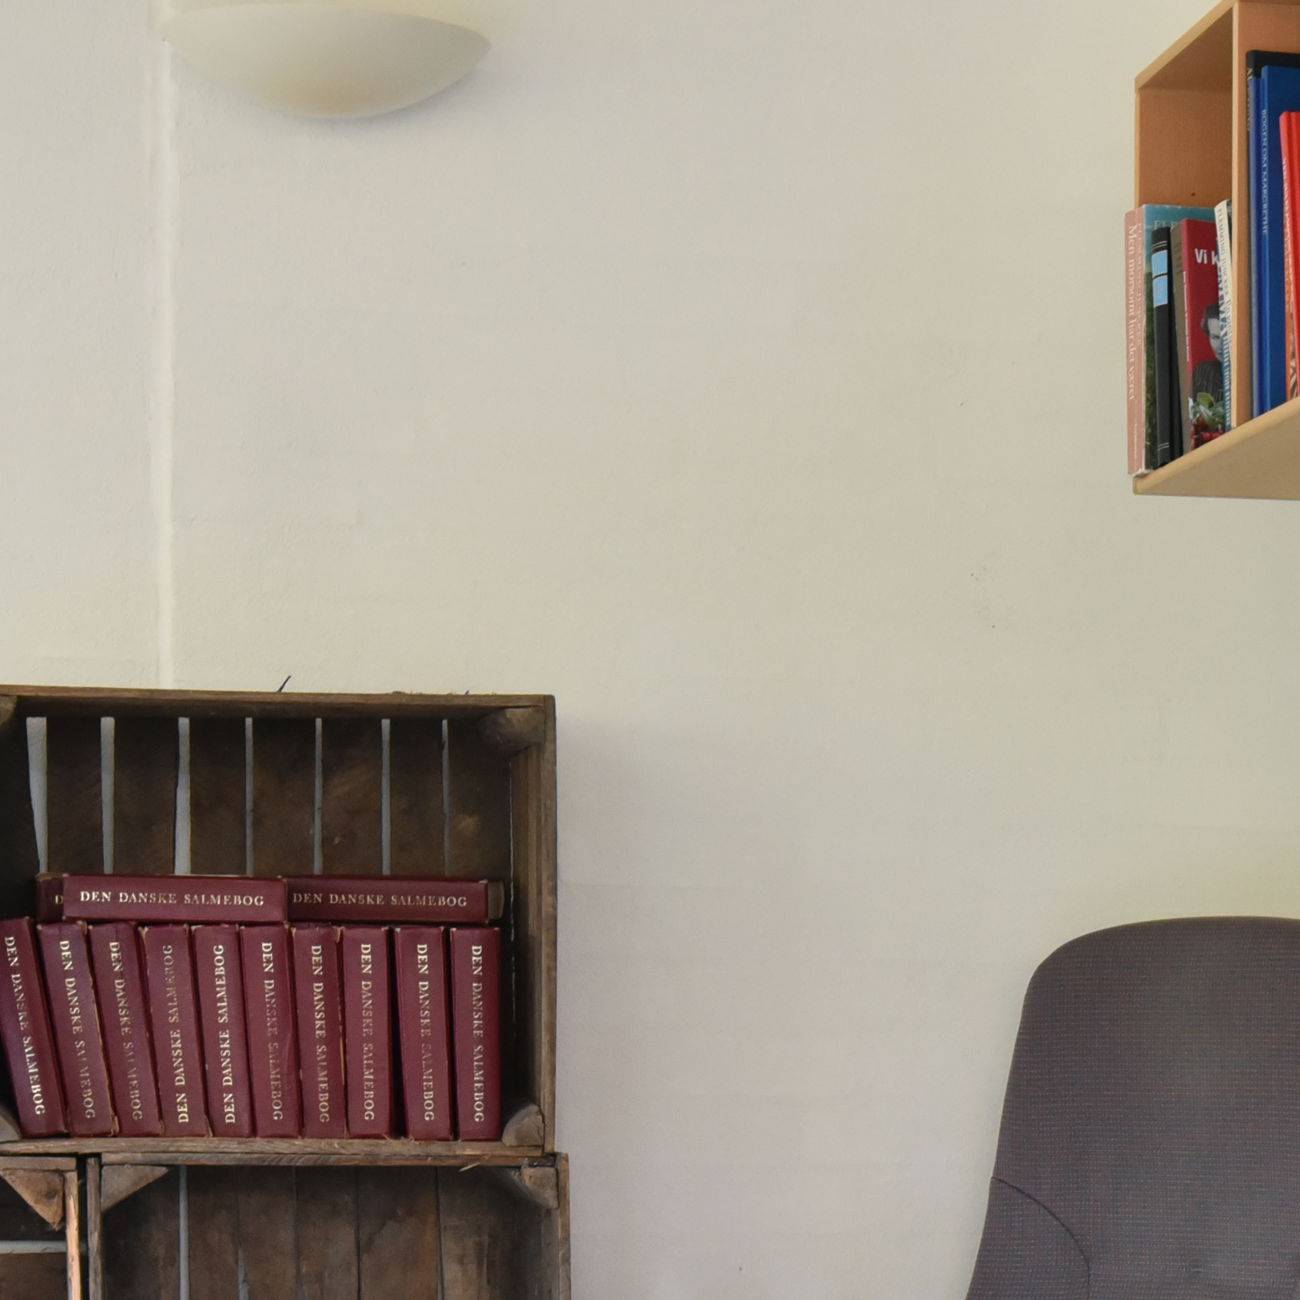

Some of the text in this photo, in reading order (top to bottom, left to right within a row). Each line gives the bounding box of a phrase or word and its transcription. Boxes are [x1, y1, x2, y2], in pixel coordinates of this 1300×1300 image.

[1195, 248, 1207, 264] Vi
[80, 891, 264, 906] DEN DANSKE SALMEBOG
[293, 893, 467, 907] DEN DANSKE SALMEBOG
[5, 936, 45, 1115] DEN DANSKE SALMEBOG
[59, 940, 95, 1119] DEN DANSKE SALMEBOG
[109, 941, 142, 1120] DEN DANSKE SALMEBOG
[163, 944, 188, 1123] DEN DANSKE SALMEBOG
[213, 944, 235, 1123] DEN DANSKE SALMEBOG
[262, 942, 283, 1120] DEN DANSKE SALMEBOG
[311, 945, 330, 1123] DEN DANSKE SALMEBOG
[361, 944, 375, 1121] DEN DANSKE SALMEBOG
[417, 944, 435, 1121] DEN DANSKE SALMEBOG
[472, 945, 485, 1122] DEN DANSKE SALMEBOG
